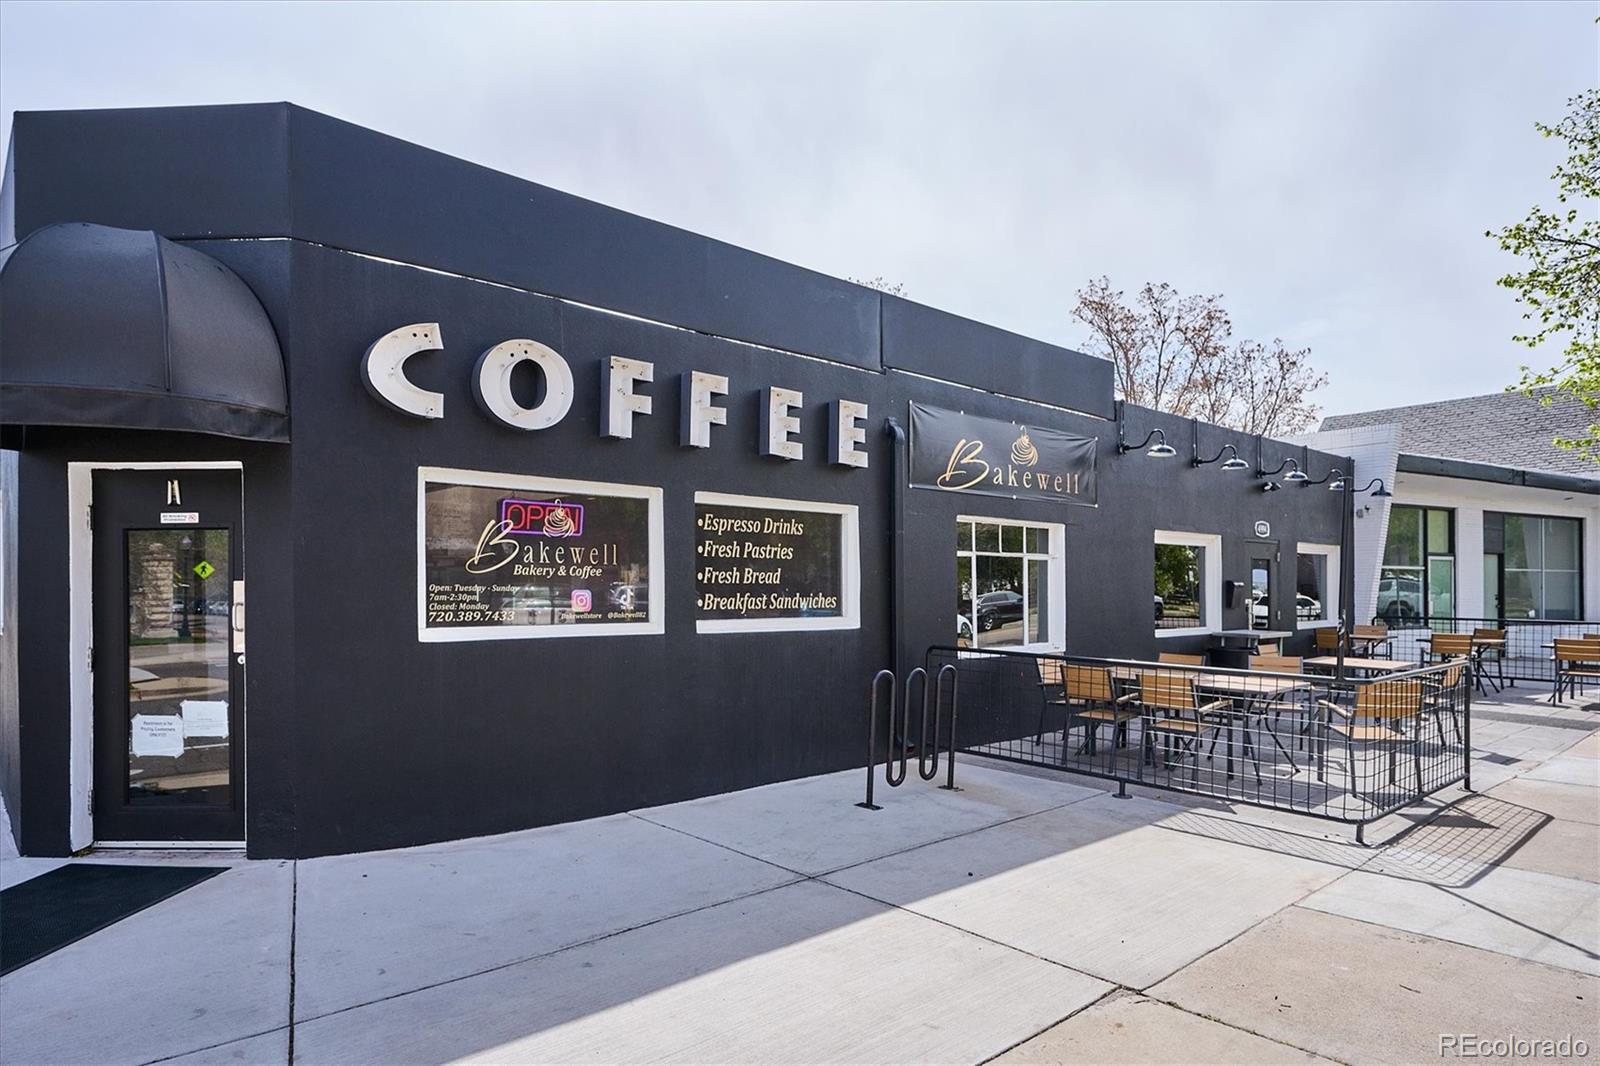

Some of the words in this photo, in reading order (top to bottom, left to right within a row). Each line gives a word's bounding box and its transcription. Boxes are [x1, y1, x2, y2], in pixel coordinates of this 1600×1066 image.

[362, 322, 868, 468] COFFEE
[936, 438, 1080, 495] Bakewell
[703, 513, 760, 535] Espresso
[763, 517, 804, 536] Drinks
[465, 519, 619, 574] Bakewell
[703, 540, 740, 558] Fresh
[743, 541, 794, 560] Pastries
[513, 564, 555, 579] Bakery
[558, 565, 567, 577] &
[569, 565, 603, 580] Coffee
[703, 567, 740, 584] Fresh
[743, 567, 782, 585] Bread
[429, 583, 453, 593] Open:
[454, 583, 487, 594] Tuesday
[492, 584, 521, 594] Sunday
[429, 602, 458, 611] Closed:
[458, 602, 490, 612] Monday
[703, 593, 768, 614] Breakfast
[769, 592, 837, 610] Sandwiches
[428, 611, 515, 623] 720.389.7433
